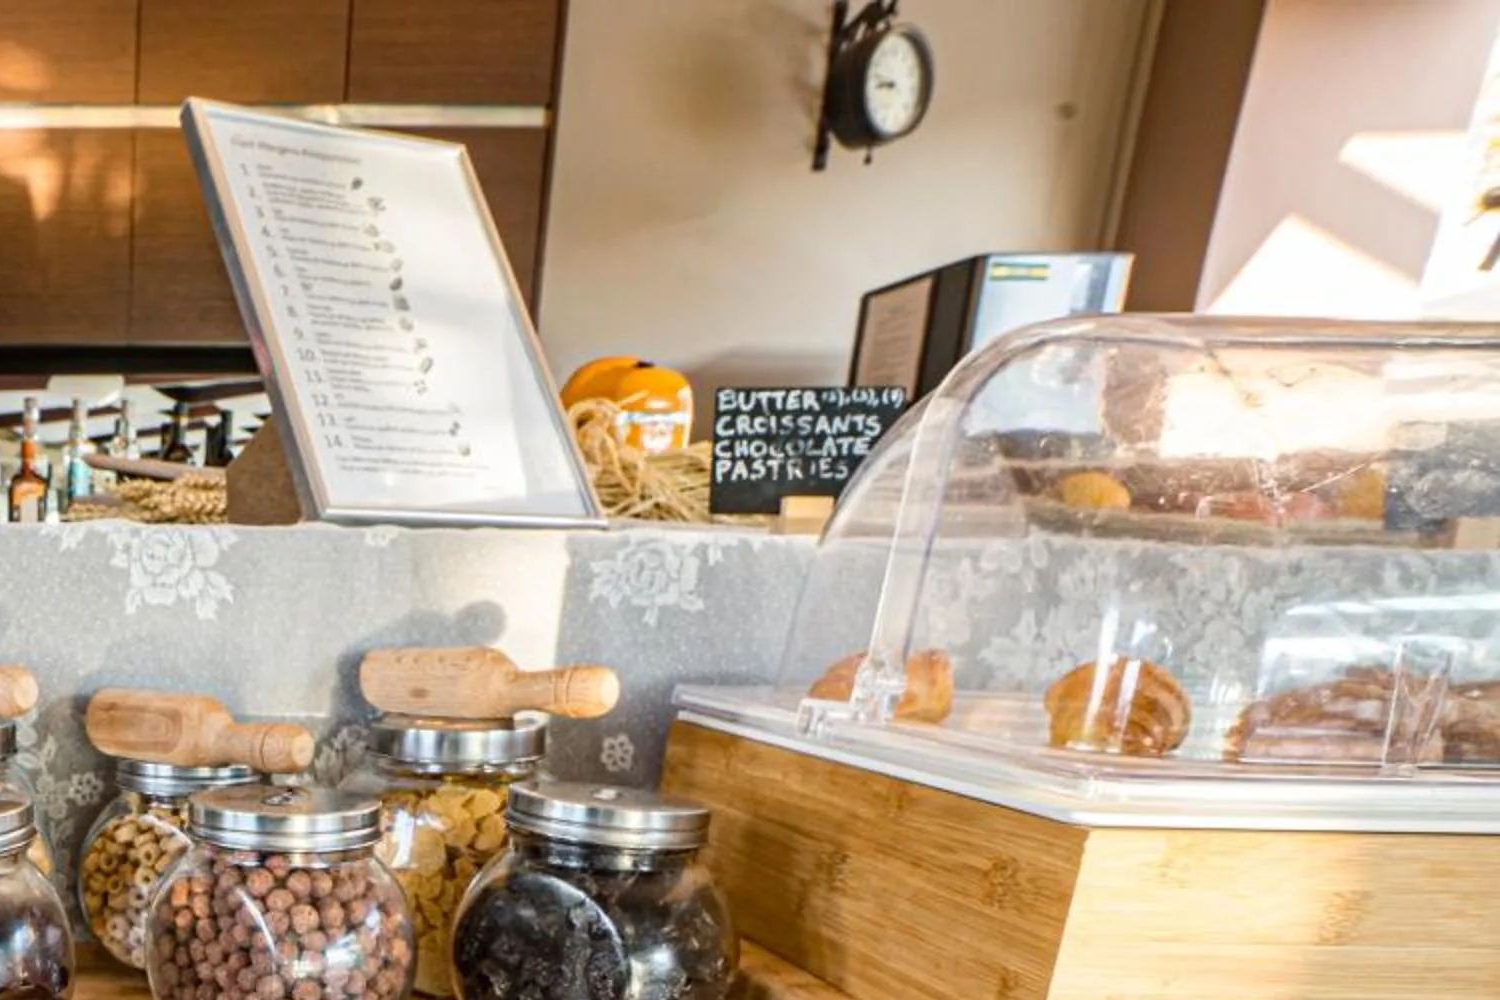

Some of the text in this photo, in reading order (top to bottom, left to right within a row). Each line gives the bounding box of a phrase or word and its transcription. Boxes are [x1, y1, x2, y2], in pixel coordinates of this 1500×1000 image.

[717, 389, 820, 413] BUTTER
[715, 414, 882, 437] CROISSANTS
[715, 436, 872, 459] CHOCOLATE
[716, 458, 849, 483] PASTRIES
